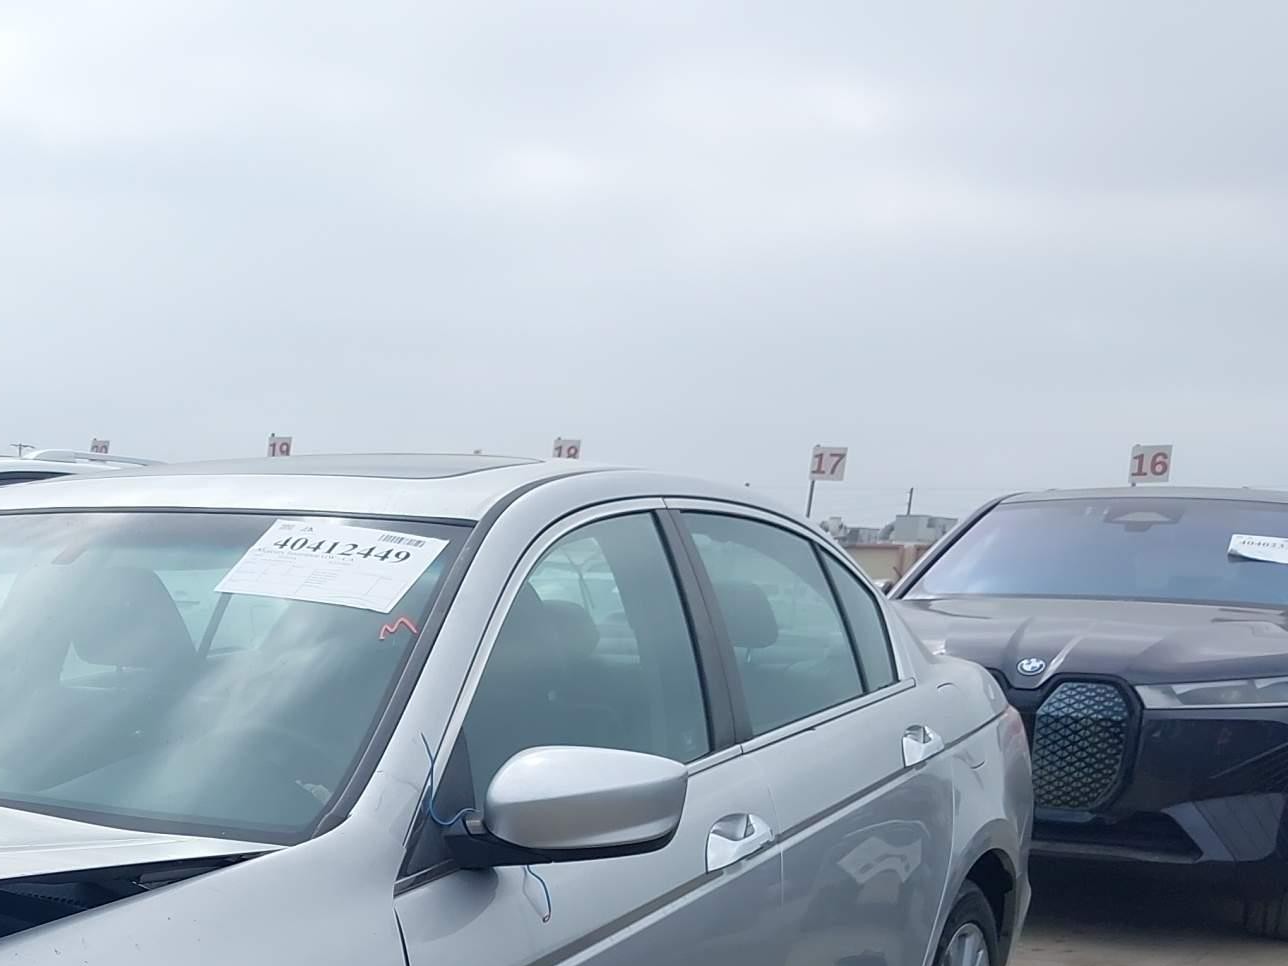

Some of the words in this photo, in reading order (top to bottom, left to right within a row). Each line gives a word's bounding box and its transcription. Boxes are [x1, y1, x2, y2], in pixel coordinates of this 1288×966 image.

[269, 442, 290, 457] 19
[811, 453, 846, 475] 17
[1131, 452, 1168, 477] 16
[273, 536, 411, 563] 40412449
